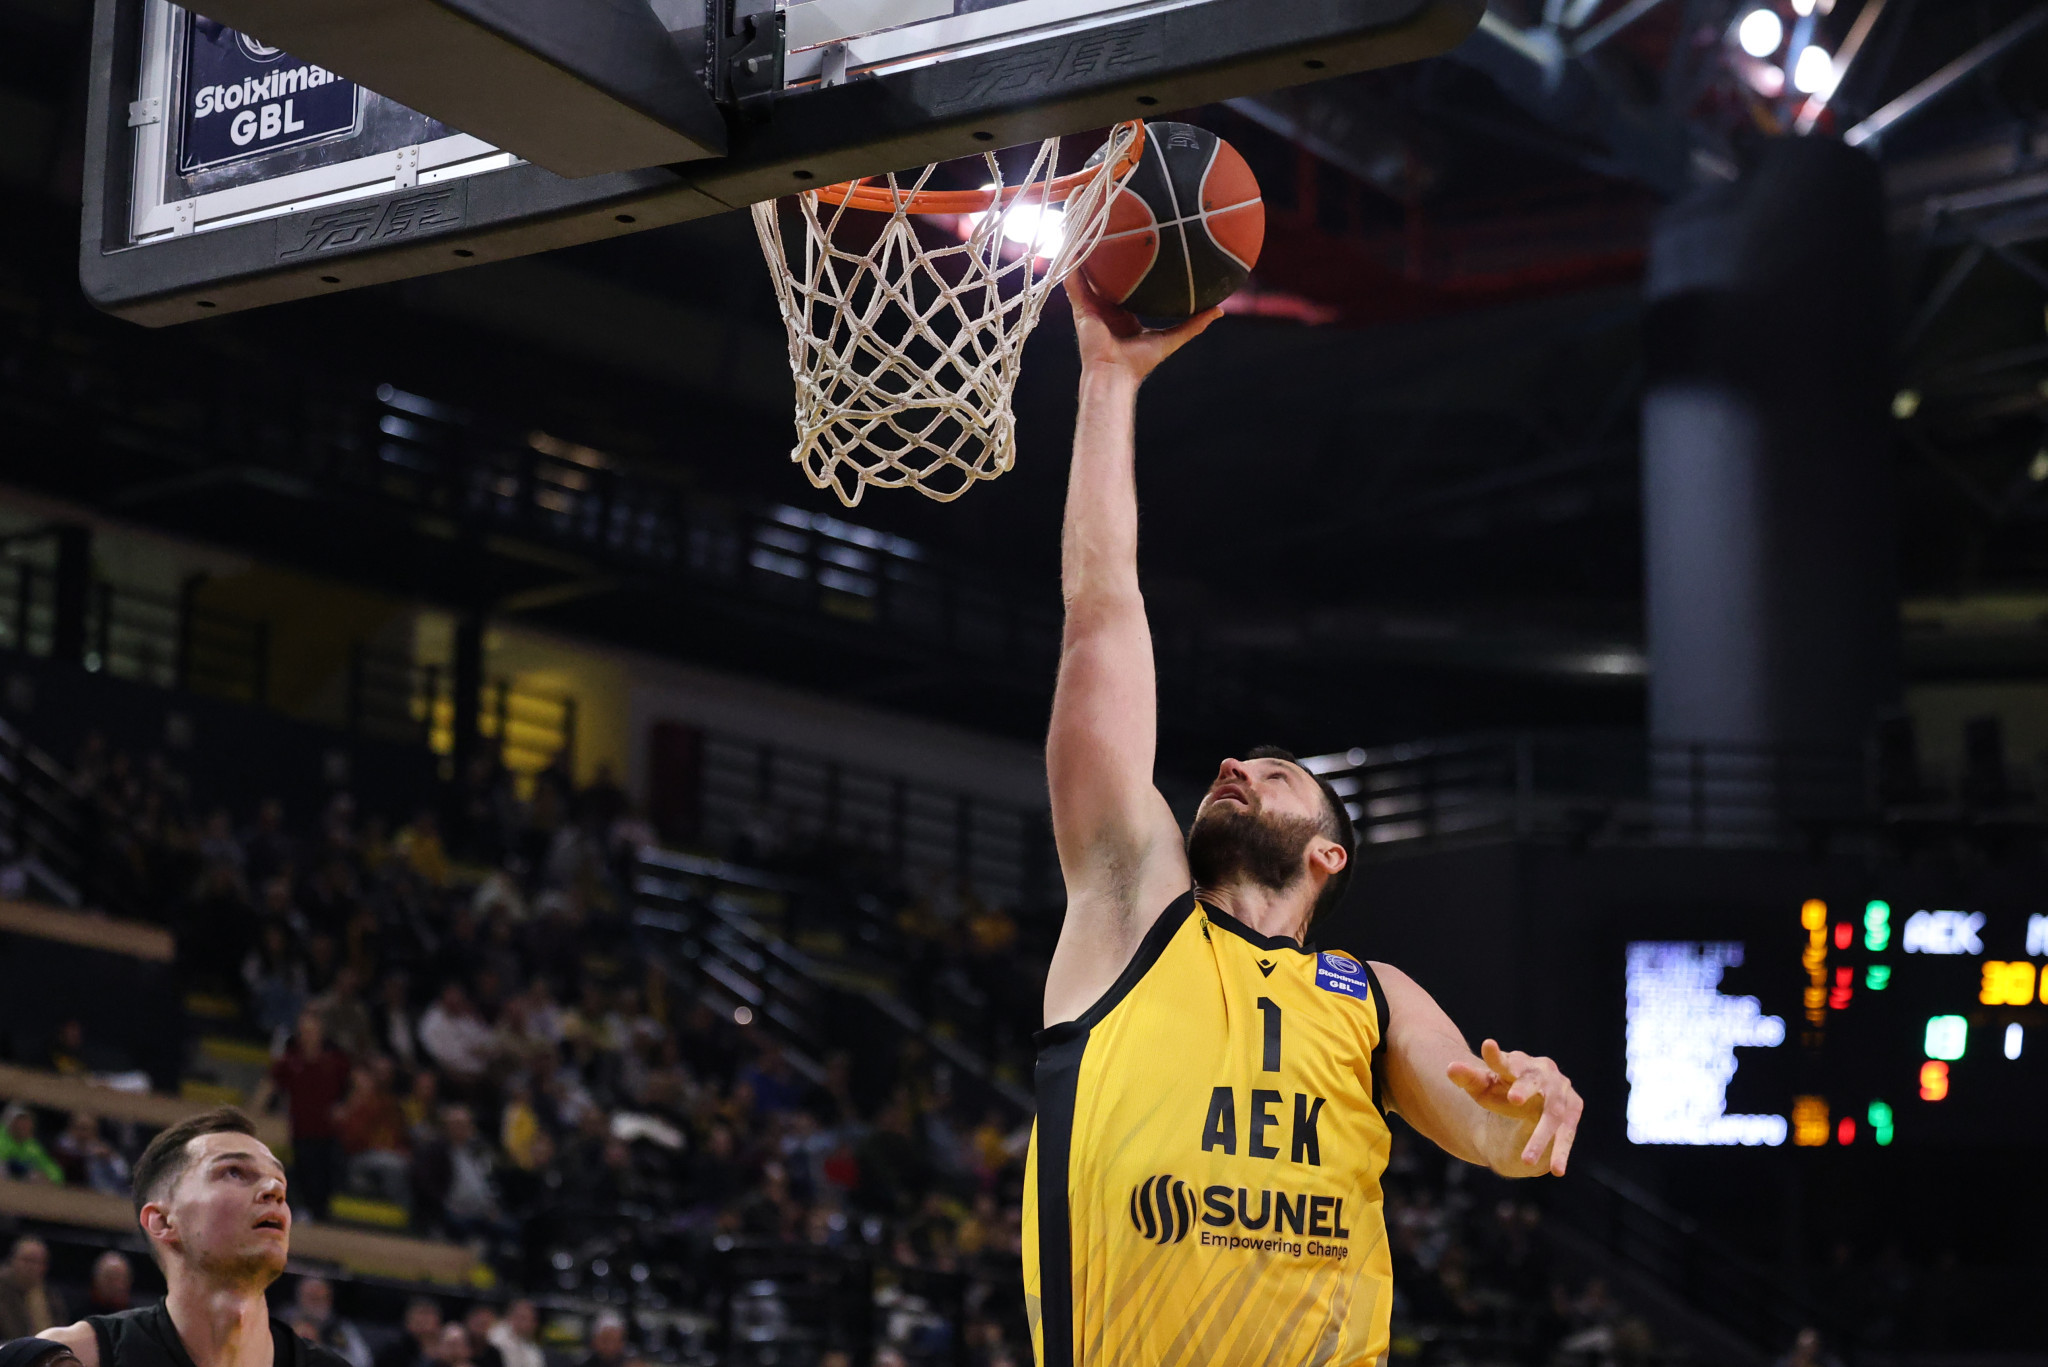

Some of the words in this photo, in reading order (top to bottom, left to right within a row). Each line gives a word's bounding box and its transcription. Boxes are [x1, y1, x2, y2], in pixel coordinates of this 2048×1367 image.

[230, 99, 304, 145] GBL
[1329, 980, 1354, 993] GBL
[1257, 996, 1282, 1072] 1
[1201, 1086, 1326, 1166] AEK
[1201, 1185, 1350, 1239] SUNEL
[1201, 1231, 1302, 1257] Empowering
[1307, 1241, 1348, 1261] Change
